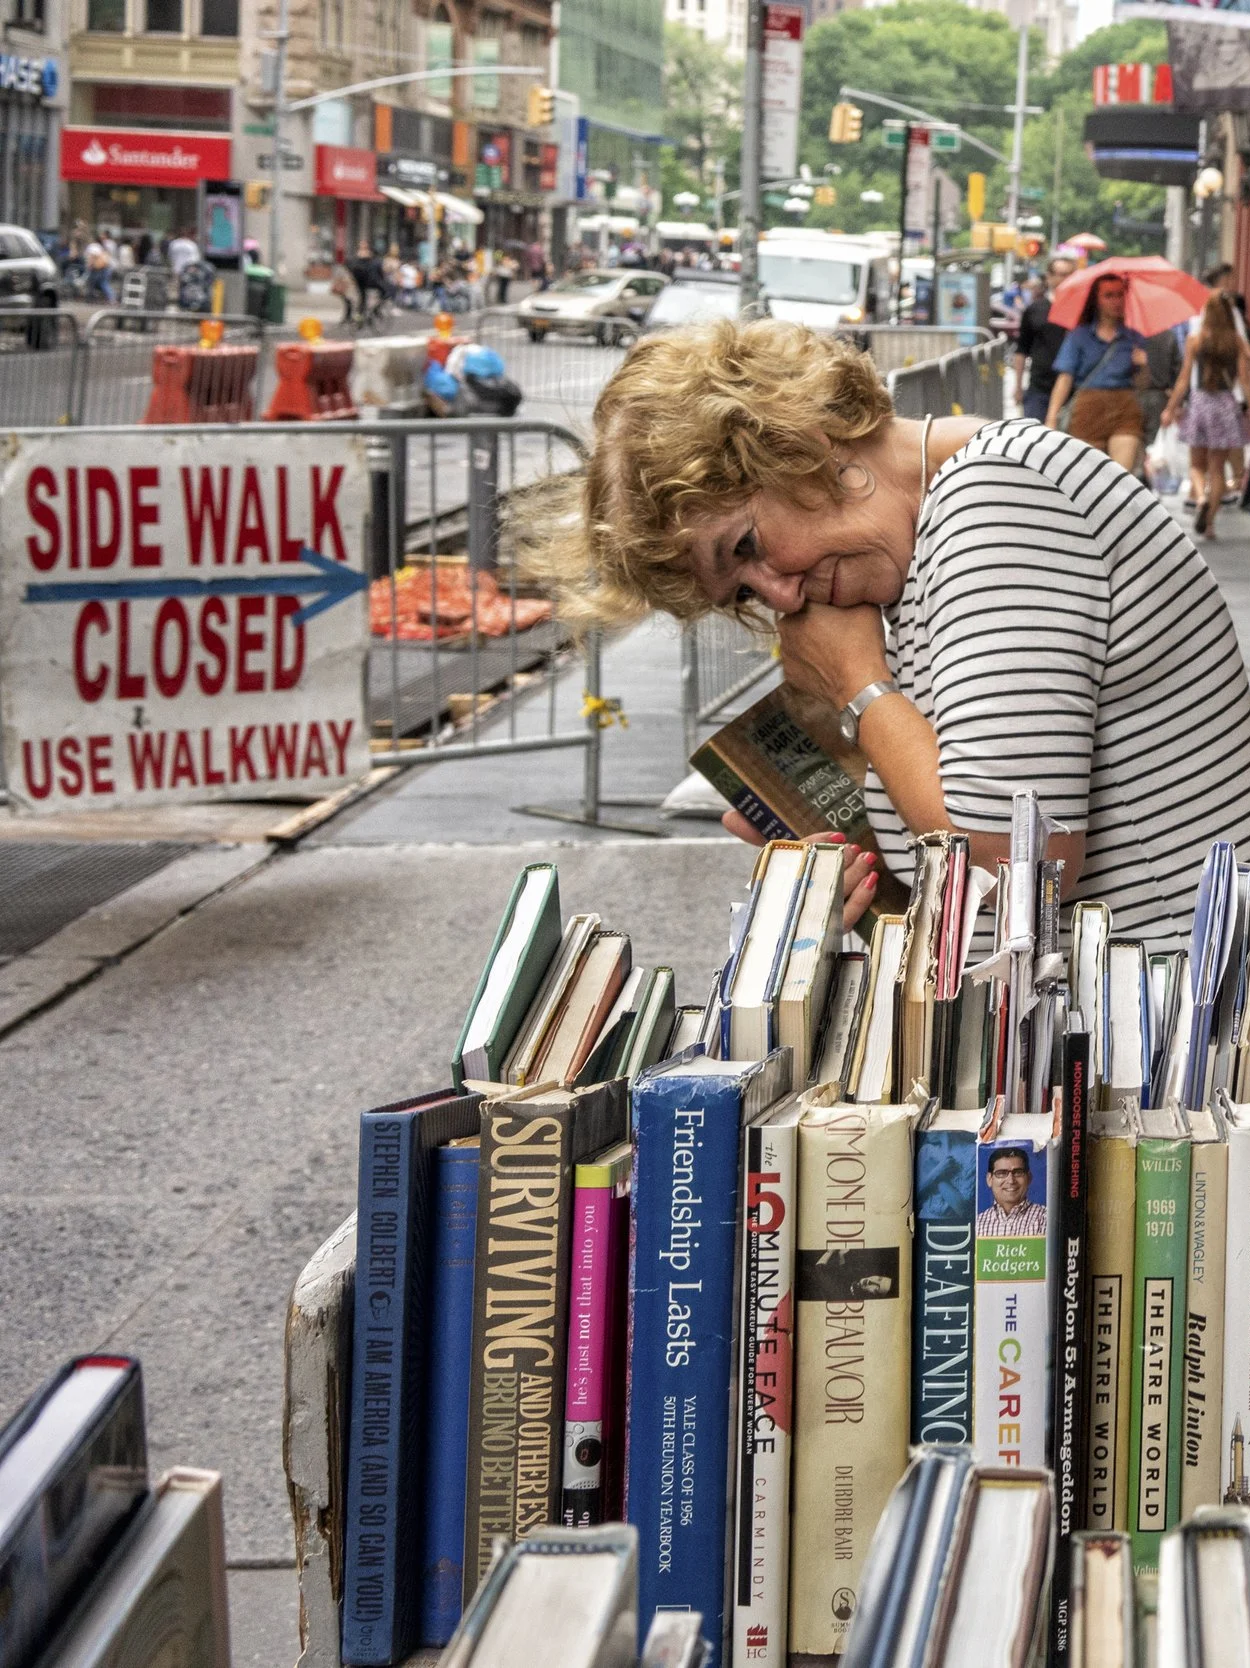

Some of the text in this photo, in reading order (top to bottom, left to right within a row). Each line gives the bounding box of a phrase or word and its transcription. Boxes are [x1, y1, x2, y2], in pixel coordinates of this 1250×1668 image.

[108, 143, 199, 169] Santander
[26, 465, 348, 571] SIDE WALK
[74, 595, 306, 702] CLOSED
[22, 719, 354, 800] USE WALKWAY
[825, 788, 866, 828] POET
[1070, 1061, 1082, 1198] MONGOOSE PUBLISHING
[1141, 1158, 1183, 1172] WILLIS
[482, 1116, 564, 1370] SURVIVING
[659, 1106, 705, 1368] Friendship Lasts
[803, 1113, 867, 1425] SIMONE DE BEAUVOIR
[982, 1258, 1040, 1273] Rodgers
[996, 1243, 1027, 1257] Rick
[1145, 1221, 1174, 1237] 1970
[1146, 1199, 1176, 1216] 1969
[572, 1204, 598, 1406] he's just not that into you
[746, 1271, 757, 1455] EASY GUIDE EVERY WOMAN
[921, 1222, 971, 1446] DEAFENING
[1004, 1293, 1017, 1332] THE
[354, 1121, 401, 1624] STEPHEN COLBERT AM AMERICA (AND SO CAN YOU!)
[481, 1371, 518, 1450] BRUNO
[516, 1371, 554, 1496] AND OTHER
[747, 1142, 786, 1600] the 5 MINUTE FACE CARMINDY
[1060, 1236, 1080, 1537] Babylon 5: Armageddon
[1092, 1286, 1113, 1518] THEATRE WORLD
[1145, 1288, 1165, 1518] THEATRE WORLD
[1185, 1311, 1207, 1468] Ralph Linton
[658, 1395, 677, 1574] 50TH REUNION YEARBOOK
[679, 1394, 697, 1526] YALE CLASS OF 1956
[834, 1465, 854, 1561] DEIRDRE BAIR
[746, 1648, 767, 1660] HC
[1057, 1598, 1068, 1652] MGP 3386
